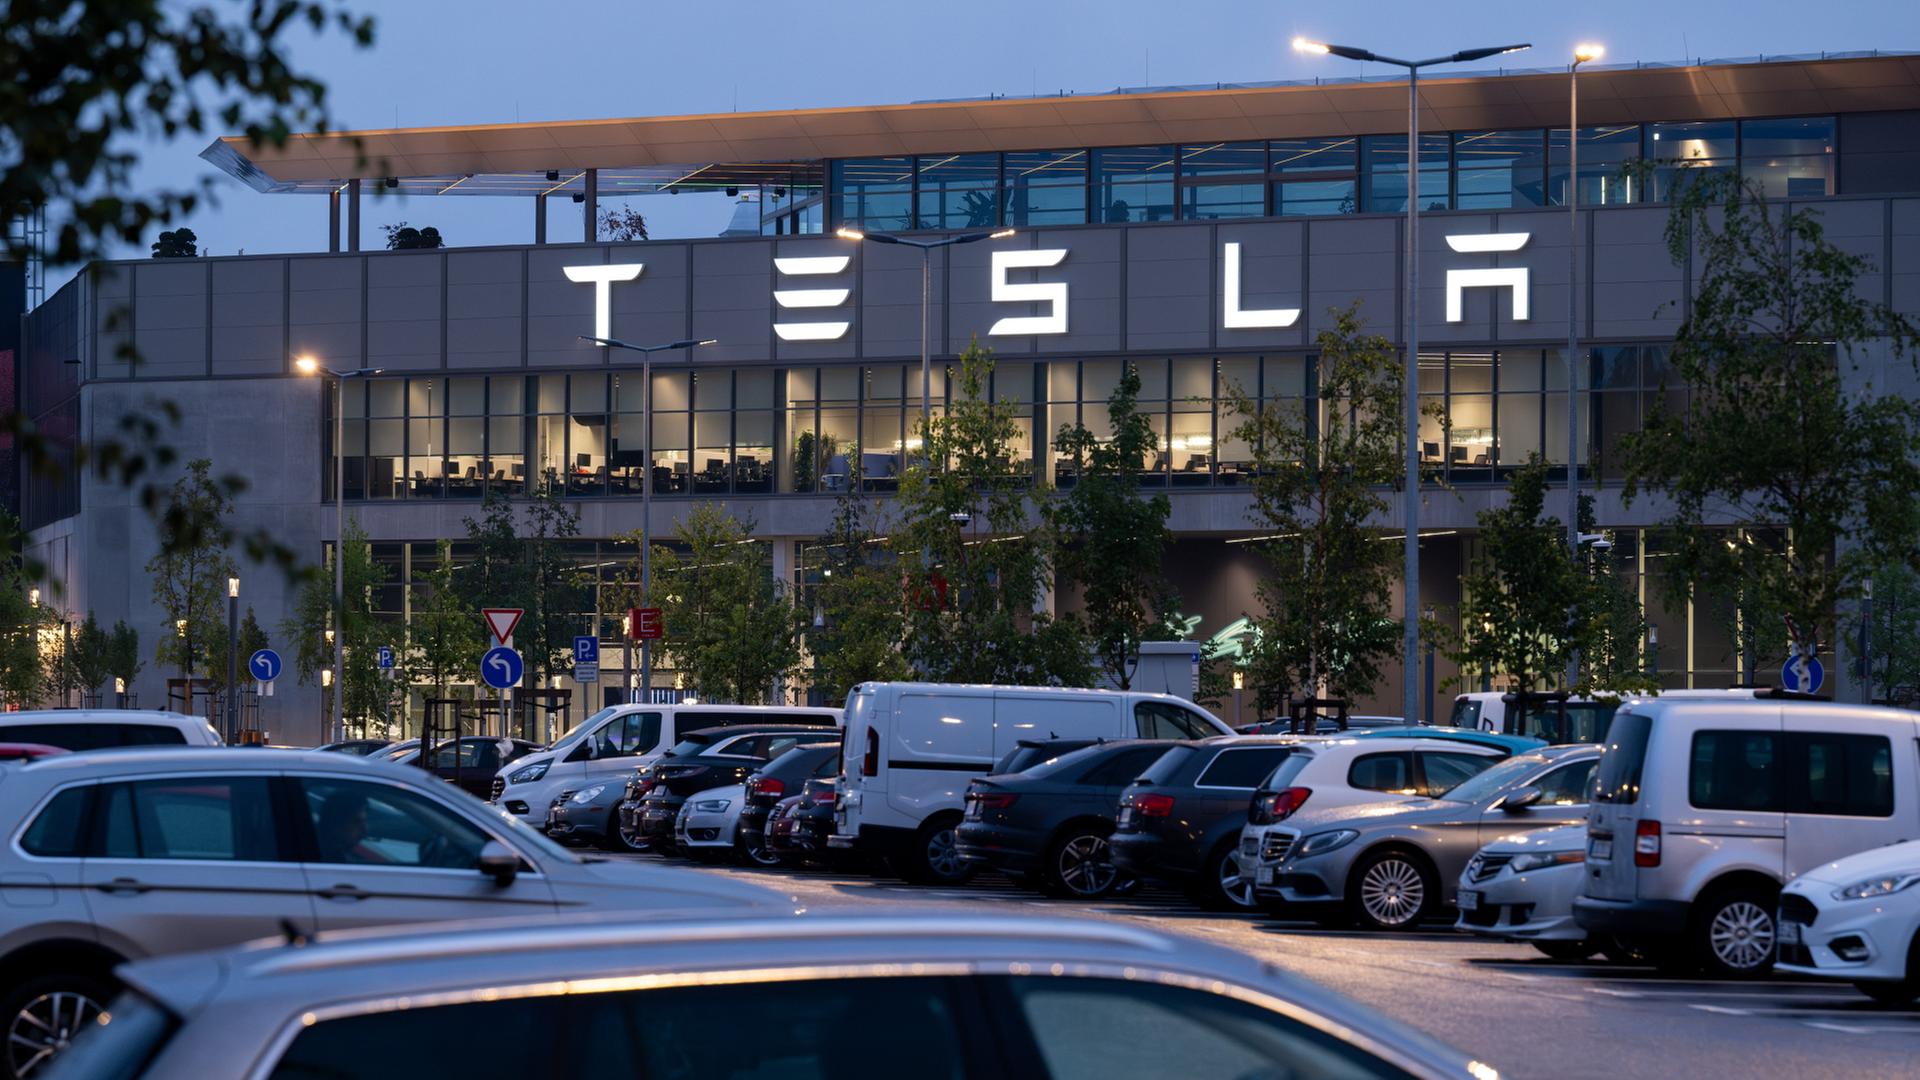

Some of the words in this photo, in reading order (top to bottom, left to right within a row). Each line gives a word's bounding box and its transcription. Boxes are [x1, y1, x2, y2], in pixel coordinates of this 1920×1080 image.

[564, 232, 1530, 344] TESLA
[640, 612, 656, 632] E
[381, 650, 391, 666] P
[578, 639, 591, 659] P
